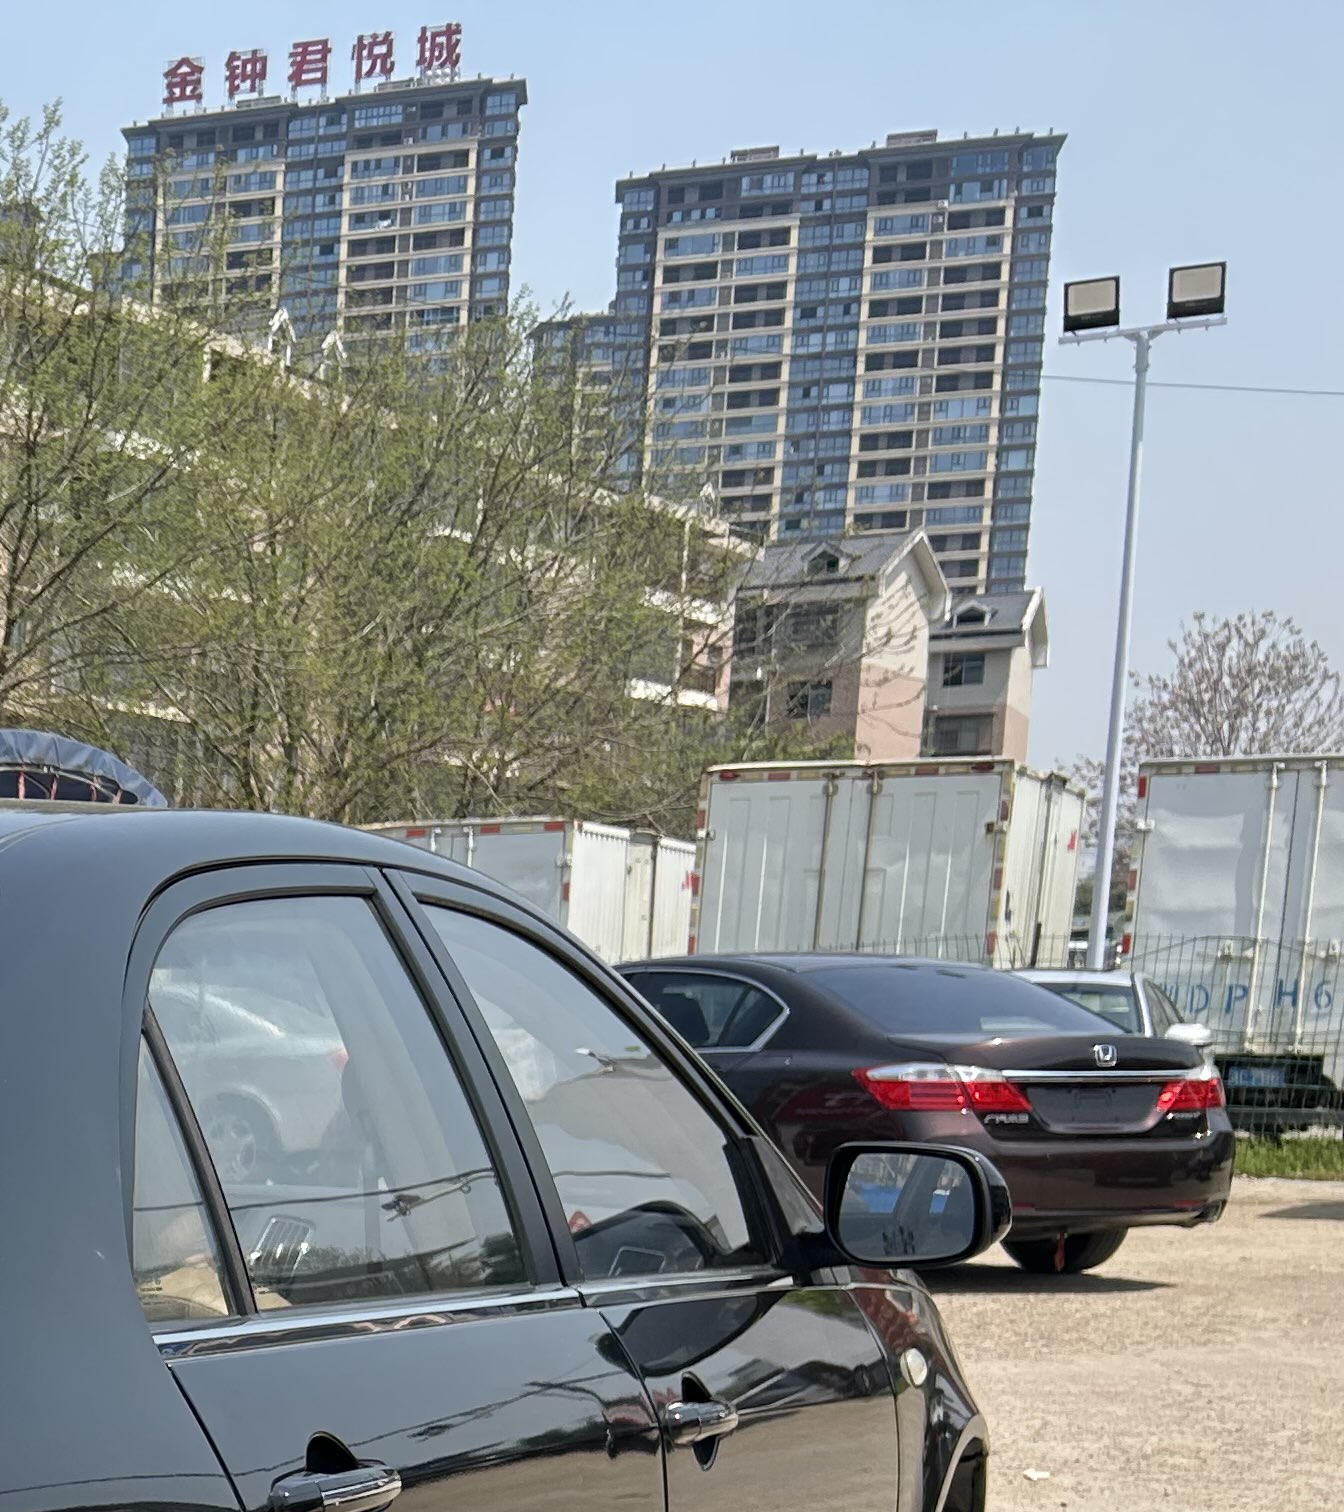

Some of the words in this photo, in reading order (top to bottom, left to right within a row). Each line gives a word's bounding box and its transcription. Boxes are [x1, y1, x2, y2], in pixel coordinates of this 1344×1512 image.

[163, 22, 463, 104] 金钟君悦城
